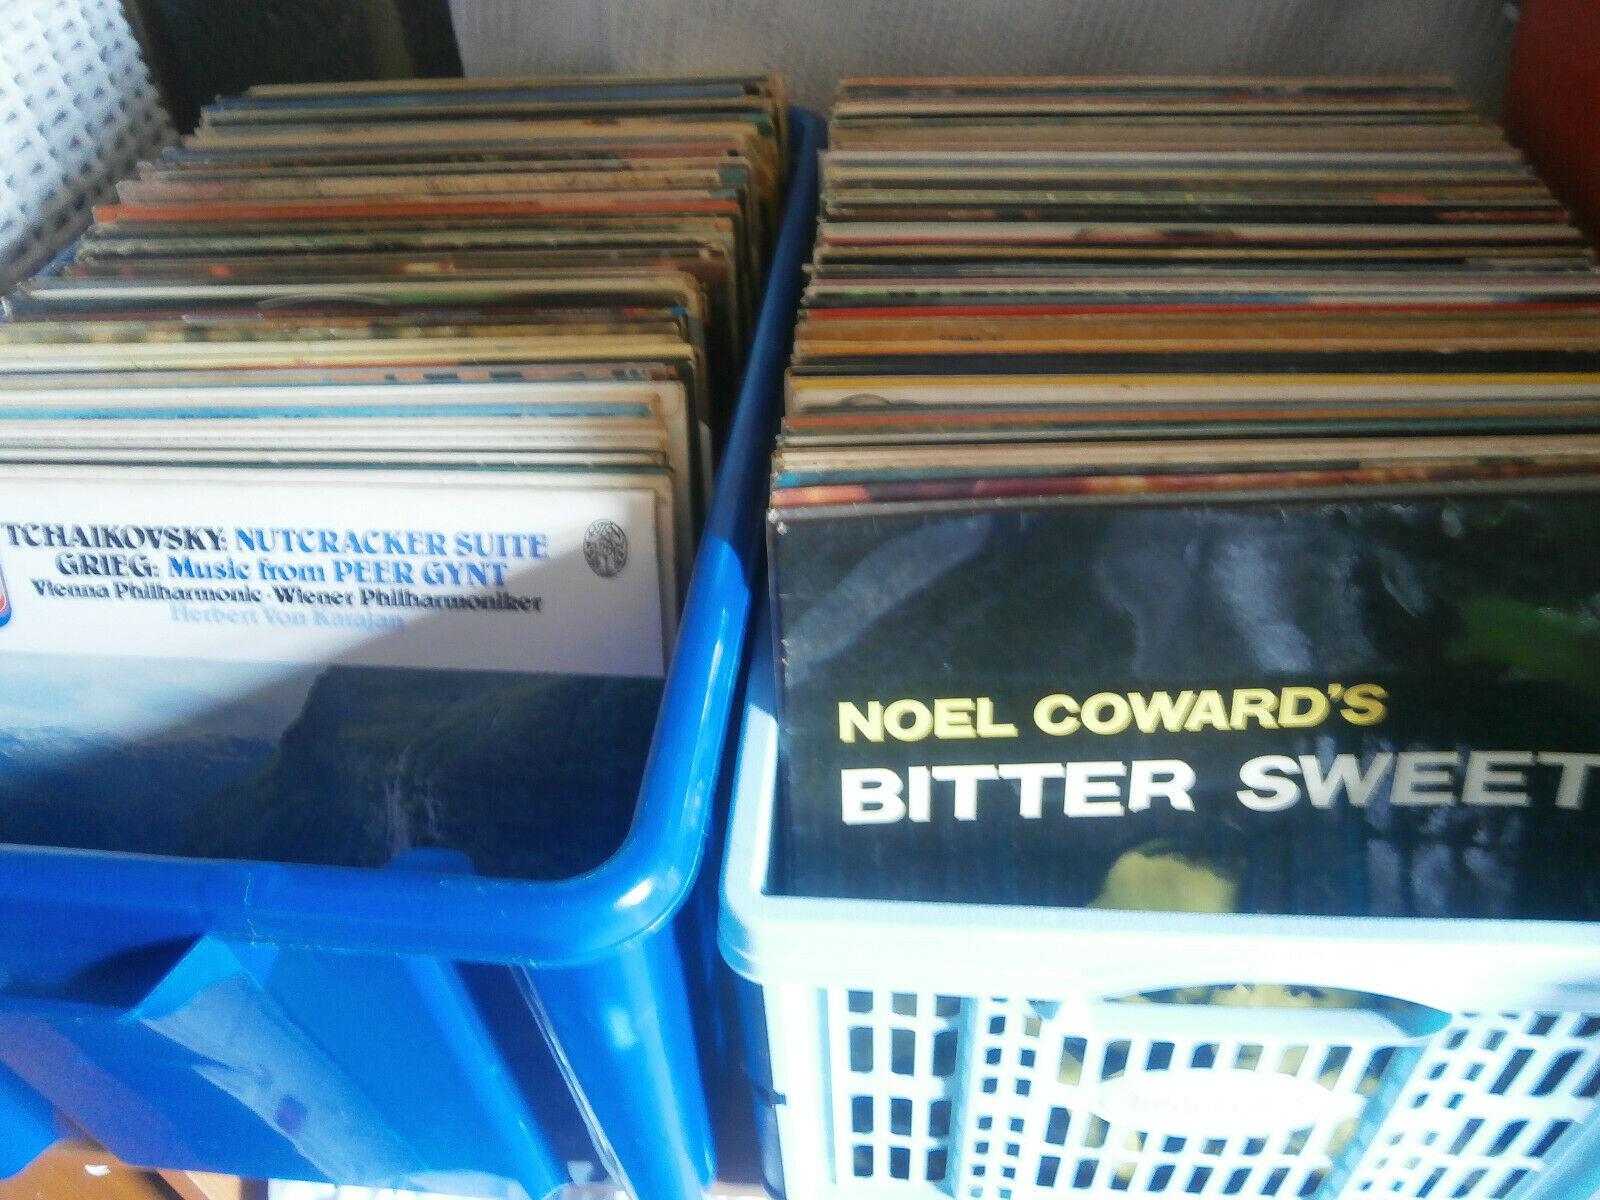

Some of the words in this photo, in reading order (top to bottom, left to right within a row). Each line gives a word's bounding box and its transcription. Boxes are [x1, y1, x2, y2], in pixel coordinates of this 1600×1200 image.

[3, 522, 228, 550] TCHAIKOVSKY:
[234, 526, 447, 556] NUTCRACKER
[453, 531, 548, 560] SUITE
[55, 551, 159, 577] GRIEG:
[168, 554, 249, 580] Music
[256, 556, 326, 582] from
[332, 559, 415, 584] PEER
[421, 561, 508, 587] GYNT
[30, 577, 109, 599] Vienna
[113, 580, 262, 602] Philharmonic
[272, 586, 354, 606] Wiener
[358, 588, 543, 613] Philharmoniker
[169, 602, 257, 623] Herbert
[261, 606, 306, 626] Von
[313, 608, 405, 631] Karajan
[838, 697, 1018, 743] NOEL
[1033, 684, 1388, 735] COWARD'S
[841, 759, 1196, 825] BITTER
[1236, 752, 1600, 811] SWEET
